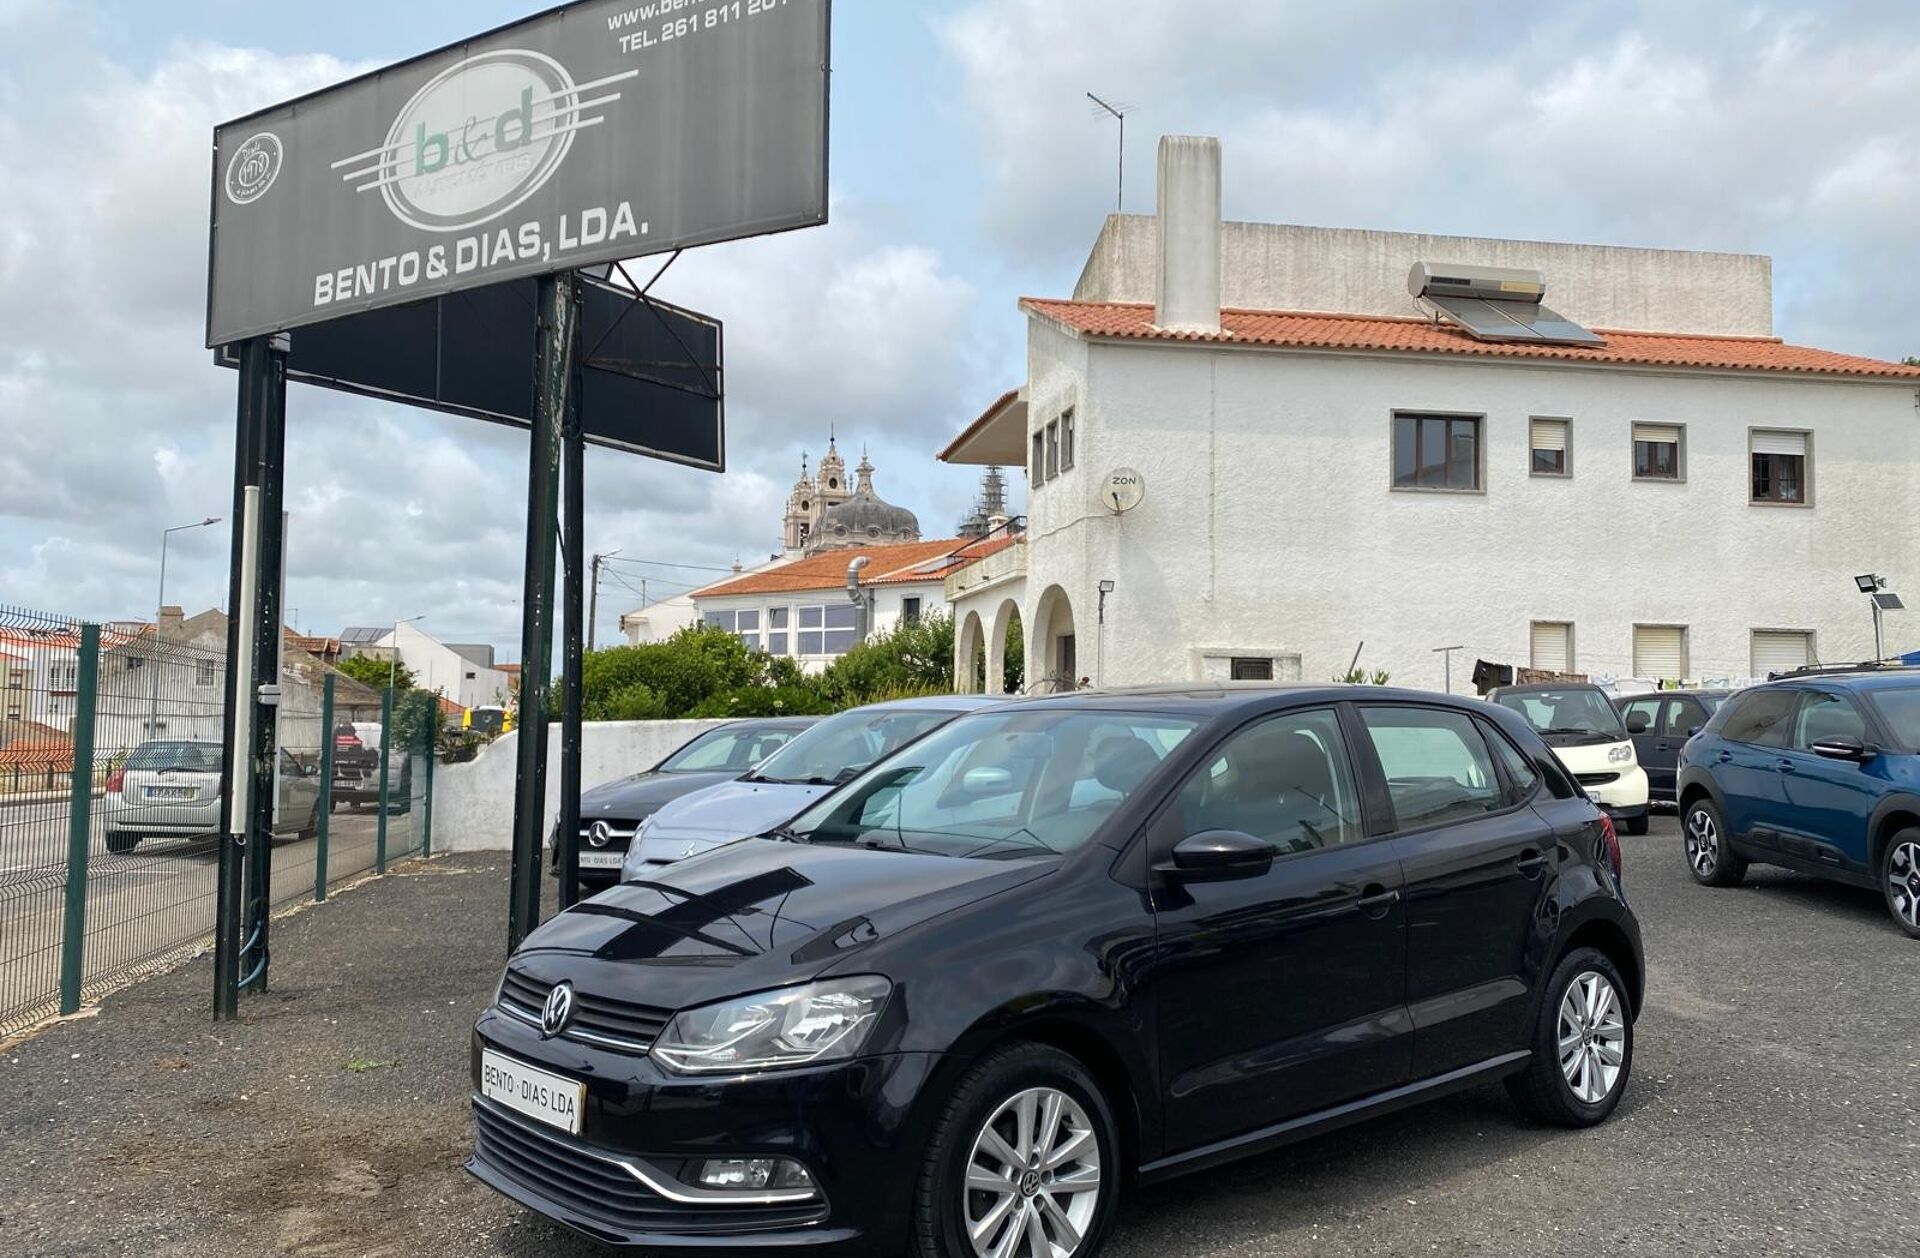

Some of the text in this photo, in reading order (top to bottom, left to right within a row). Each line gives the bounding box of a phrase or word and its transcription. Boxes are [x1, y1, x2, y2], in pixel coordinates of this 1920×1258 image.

[619, 30, 657, 54] TEL.
[661, 14, 698, 42] 261
[704, 1, 740, 28] 811
[313, 200, 649, 306] BENTO & DIAS, LDA.
[1112, 476, 1136, 485] ZON
[485, 1064, 575, 1117] BENTO DIAS LDA
